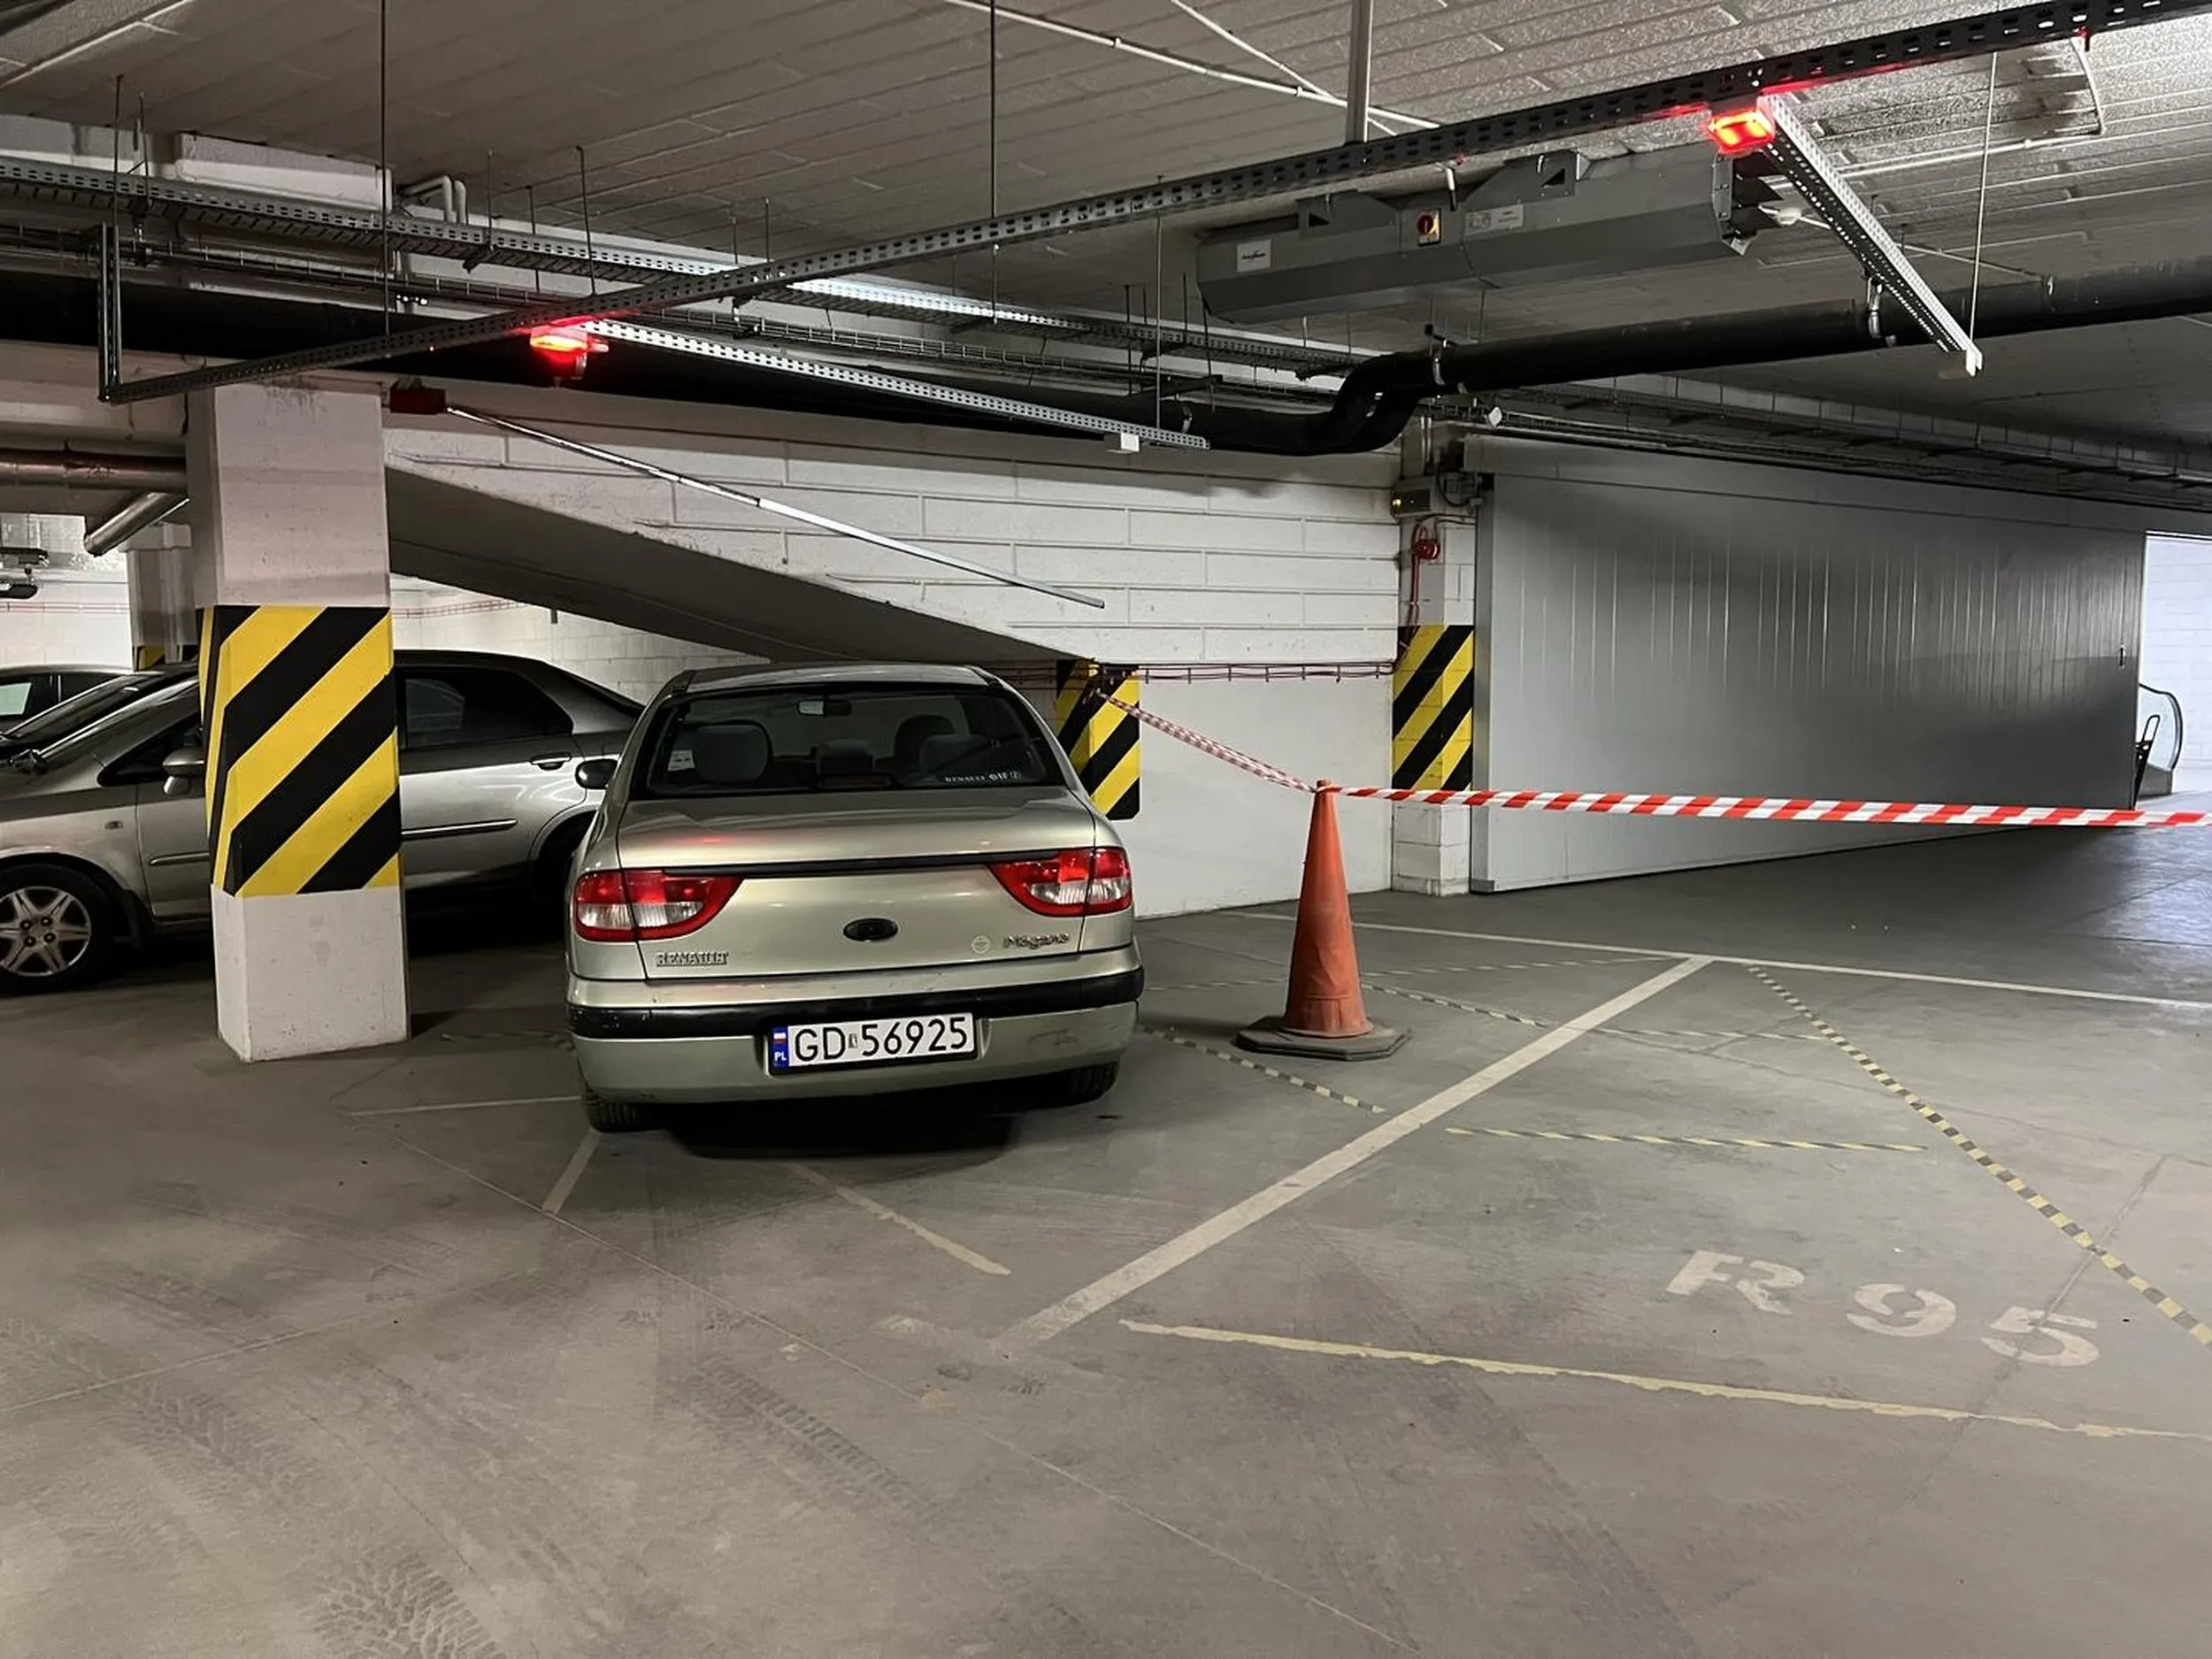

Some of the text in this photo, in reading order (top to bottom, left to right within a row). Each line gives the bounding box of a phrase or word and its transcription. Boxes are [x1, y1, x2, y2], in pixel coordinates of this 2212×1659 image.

[657, 951, 729, 967] RENAULT
[795, 1017, 968, 1062] GD 56925
[774, 1051, 787, 1063] PL
